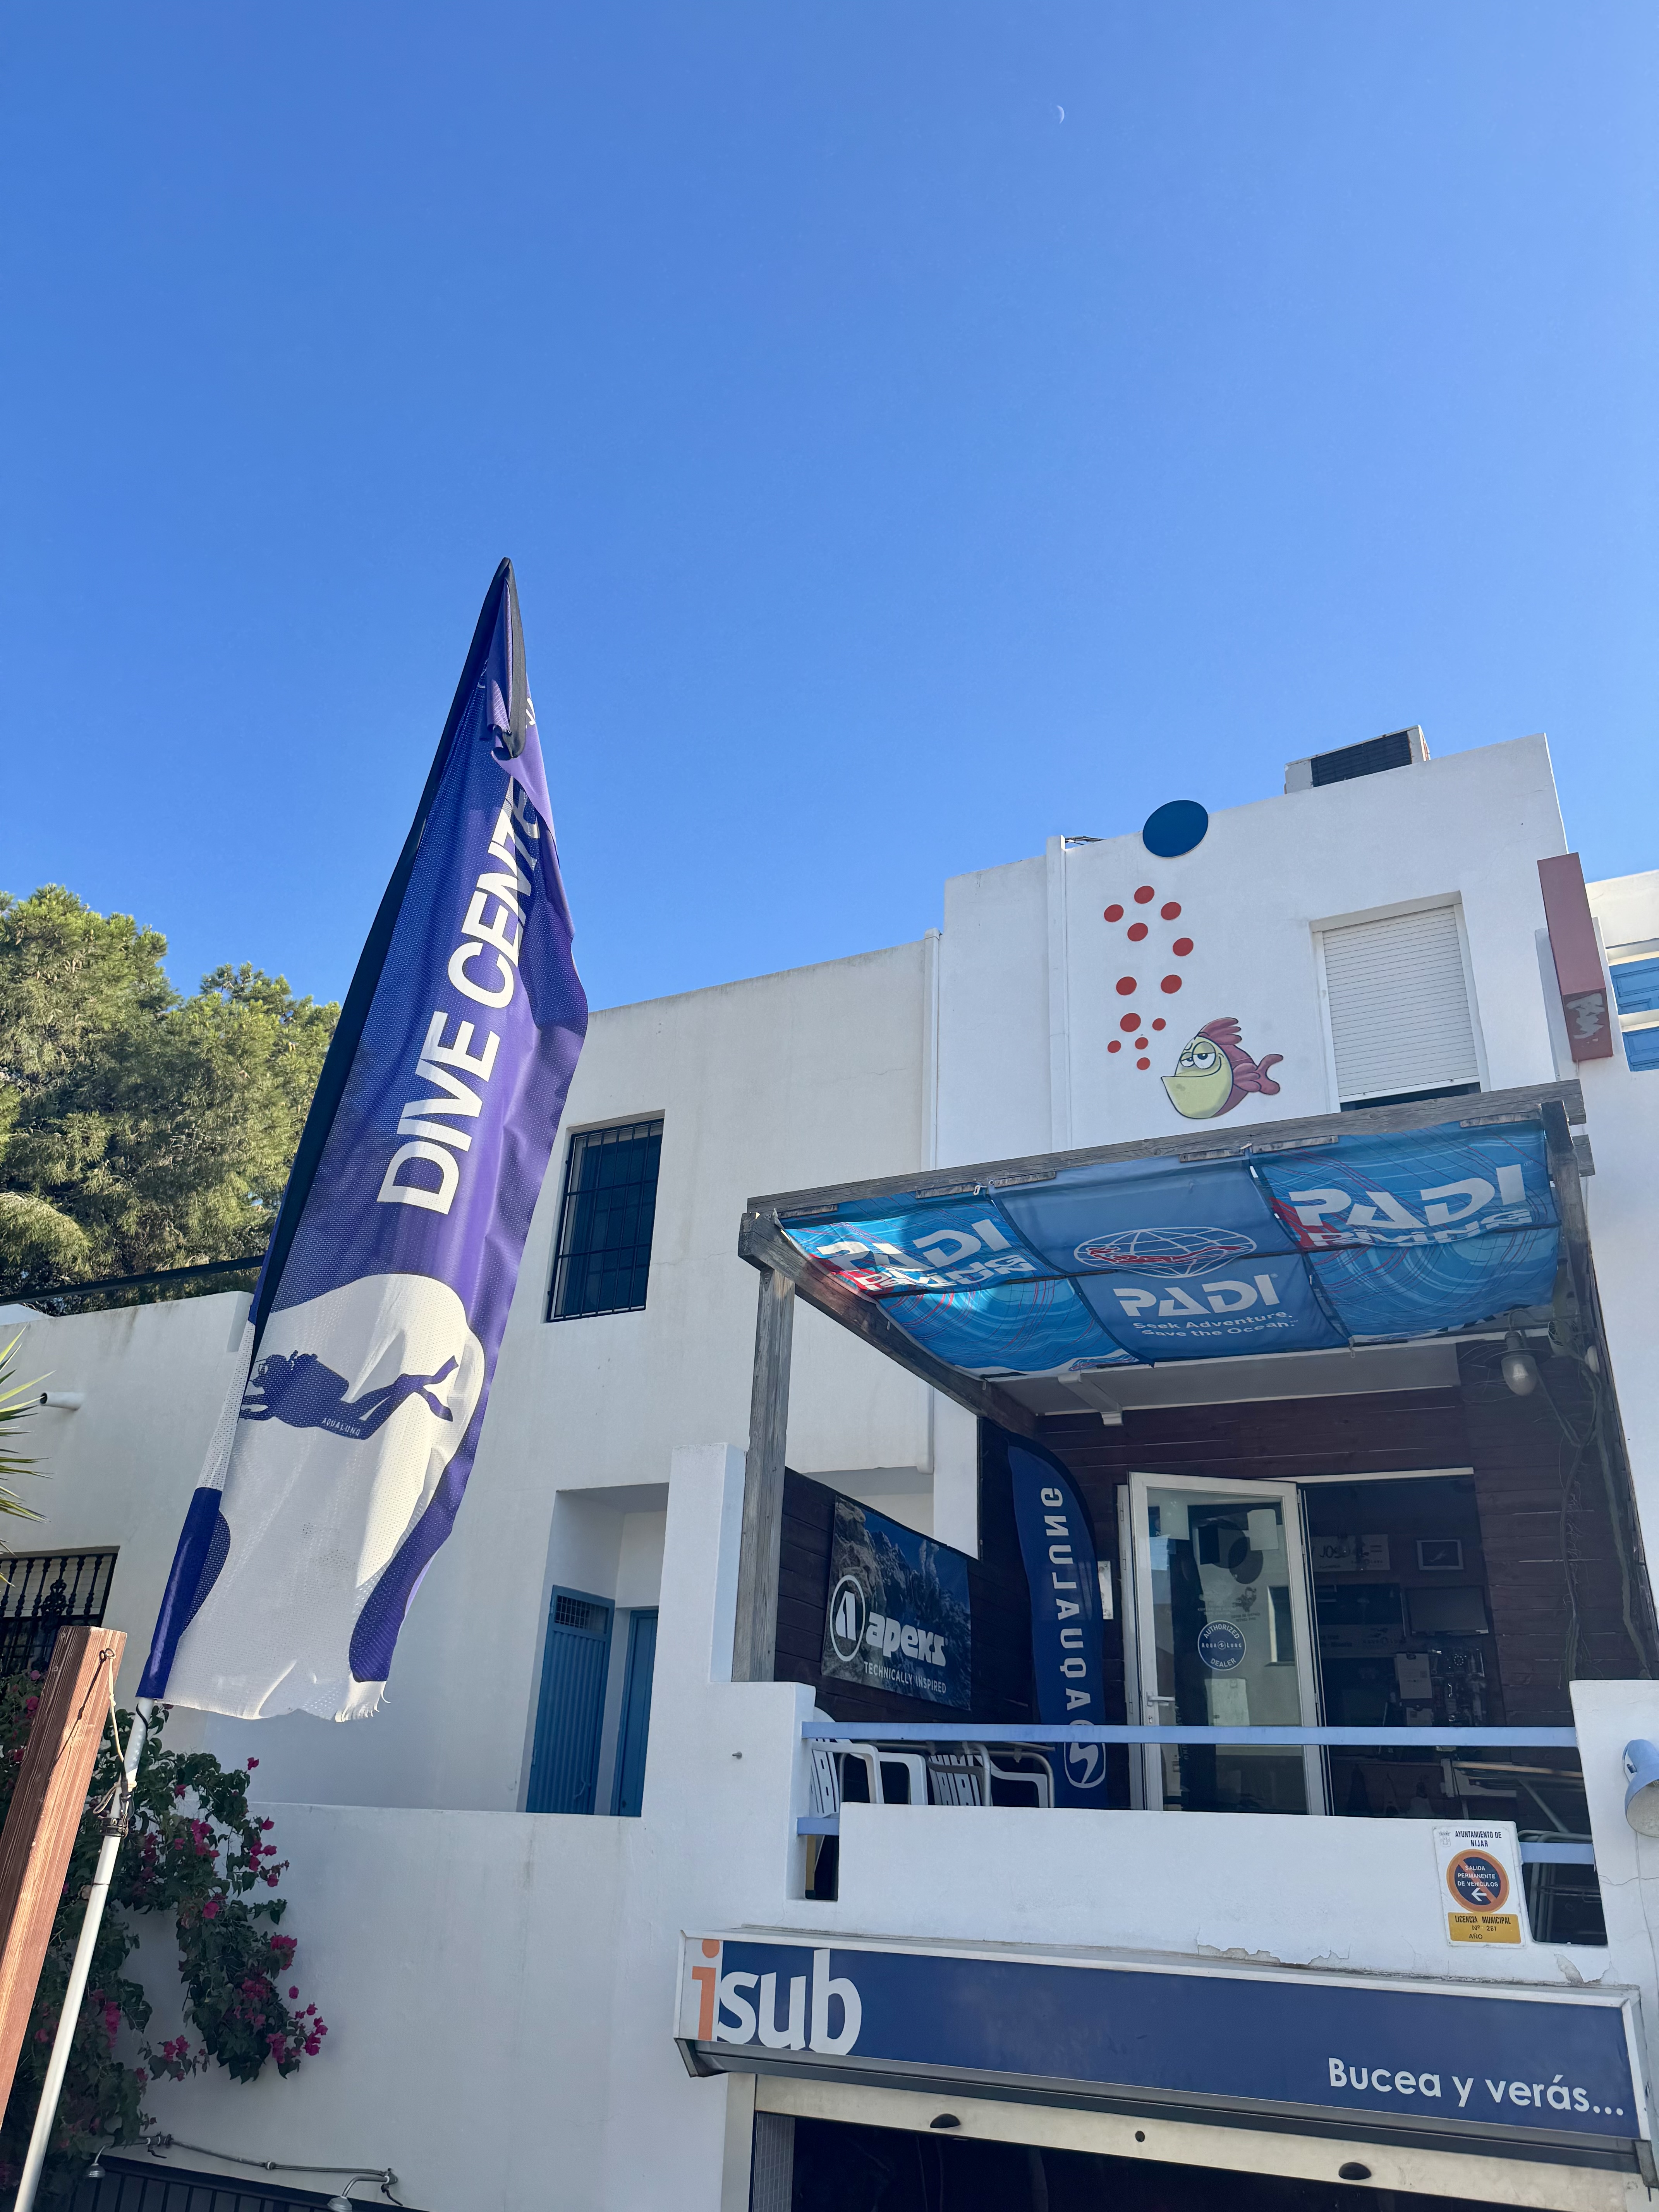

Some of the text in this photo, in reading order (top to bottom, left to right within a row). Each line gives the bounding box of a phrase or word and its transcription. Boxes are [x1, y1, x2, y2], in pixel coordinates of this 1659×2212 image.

[376, 1011, 500, 1215] DIVE
[1288, 1164, 1526, 1229] PADI
[817, 1219, 1012, 1272] PADI
[1113, 1274, 1280, 1316] PADI
[1186, 1311, 1293, 1329] Adventure.
[866, 1611, 946, 1667] apeks
[1204, 1624, 1240, 1639] AUTHORIZED
[864, 1661, 946, 1693] TECHNICALLY INSPIRED
[1211, 1658, 1237, 1668] DEALER
[1482, 1916, 1511, 1924] MUNICIPAL
[692, 1939, 862, 2056] isub
[1328, 2057, 1624, 2116] Bucea y verás...
